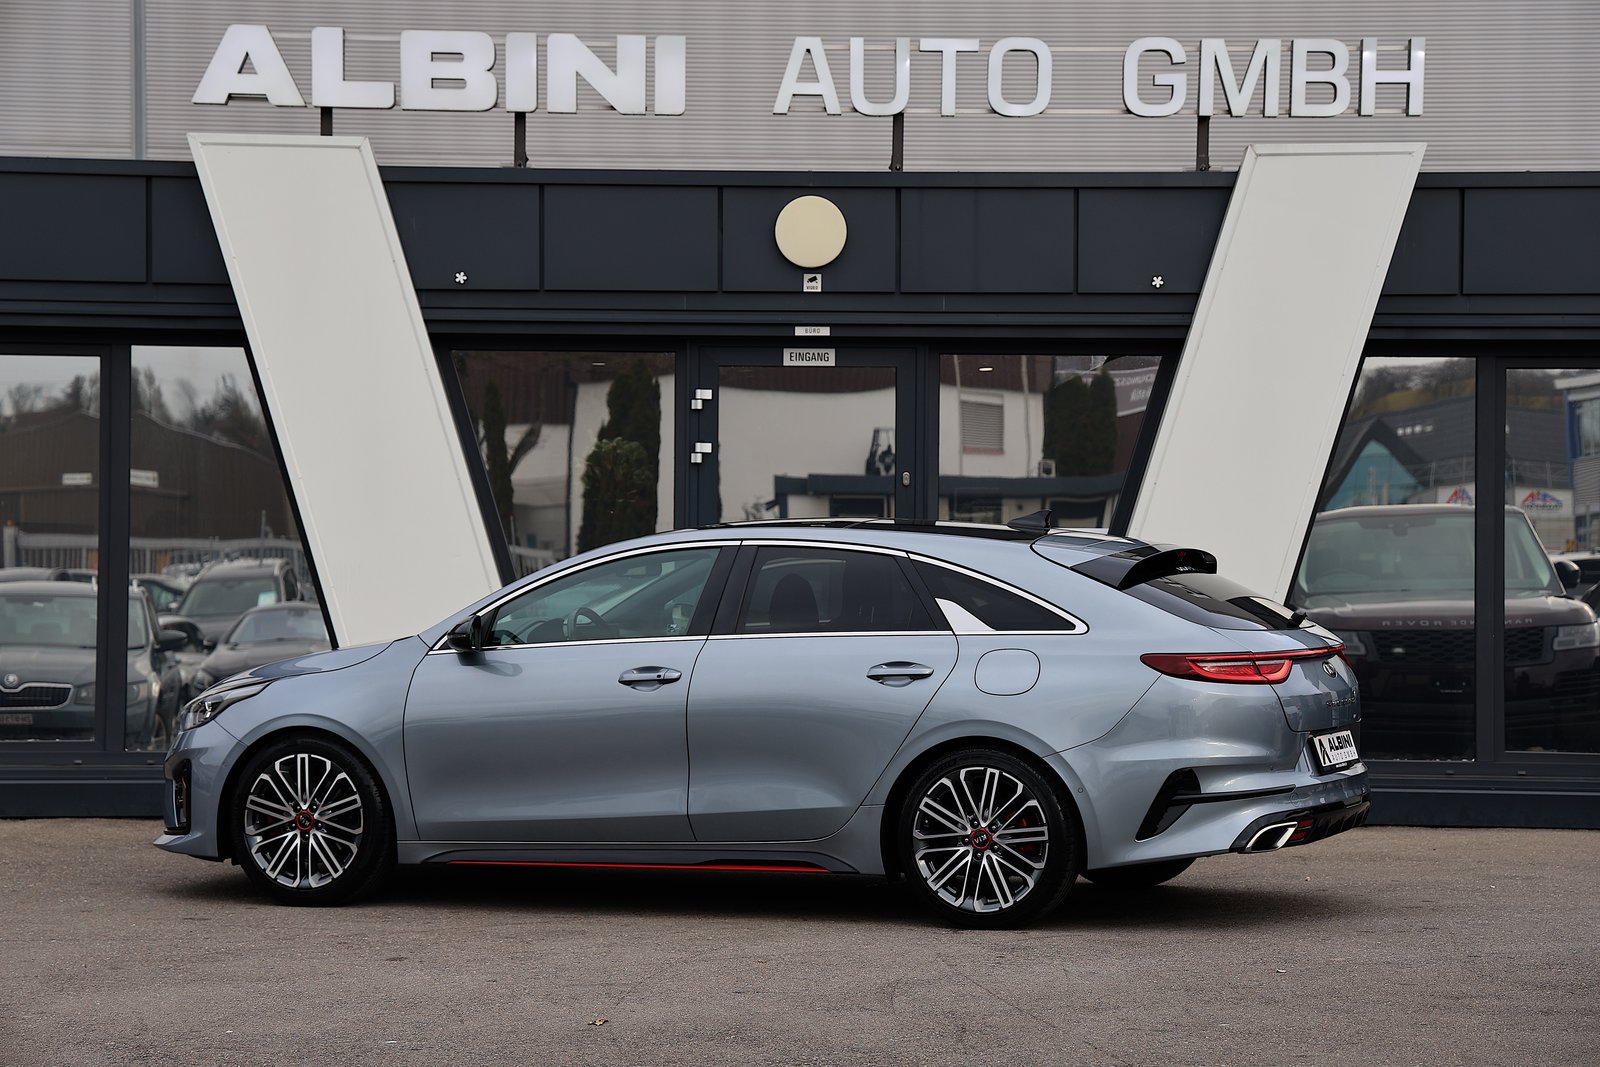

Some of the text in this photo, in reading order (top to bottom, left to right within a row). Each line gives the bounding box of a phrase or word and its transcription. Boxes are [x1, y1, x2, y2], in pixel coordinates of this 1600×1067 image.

[191, 24, 1427, 118] ALBINI AUTO GMBH
[789, 351, 830, 362] EINGANG
[1327, 733, 1354, 752] ALBINI
